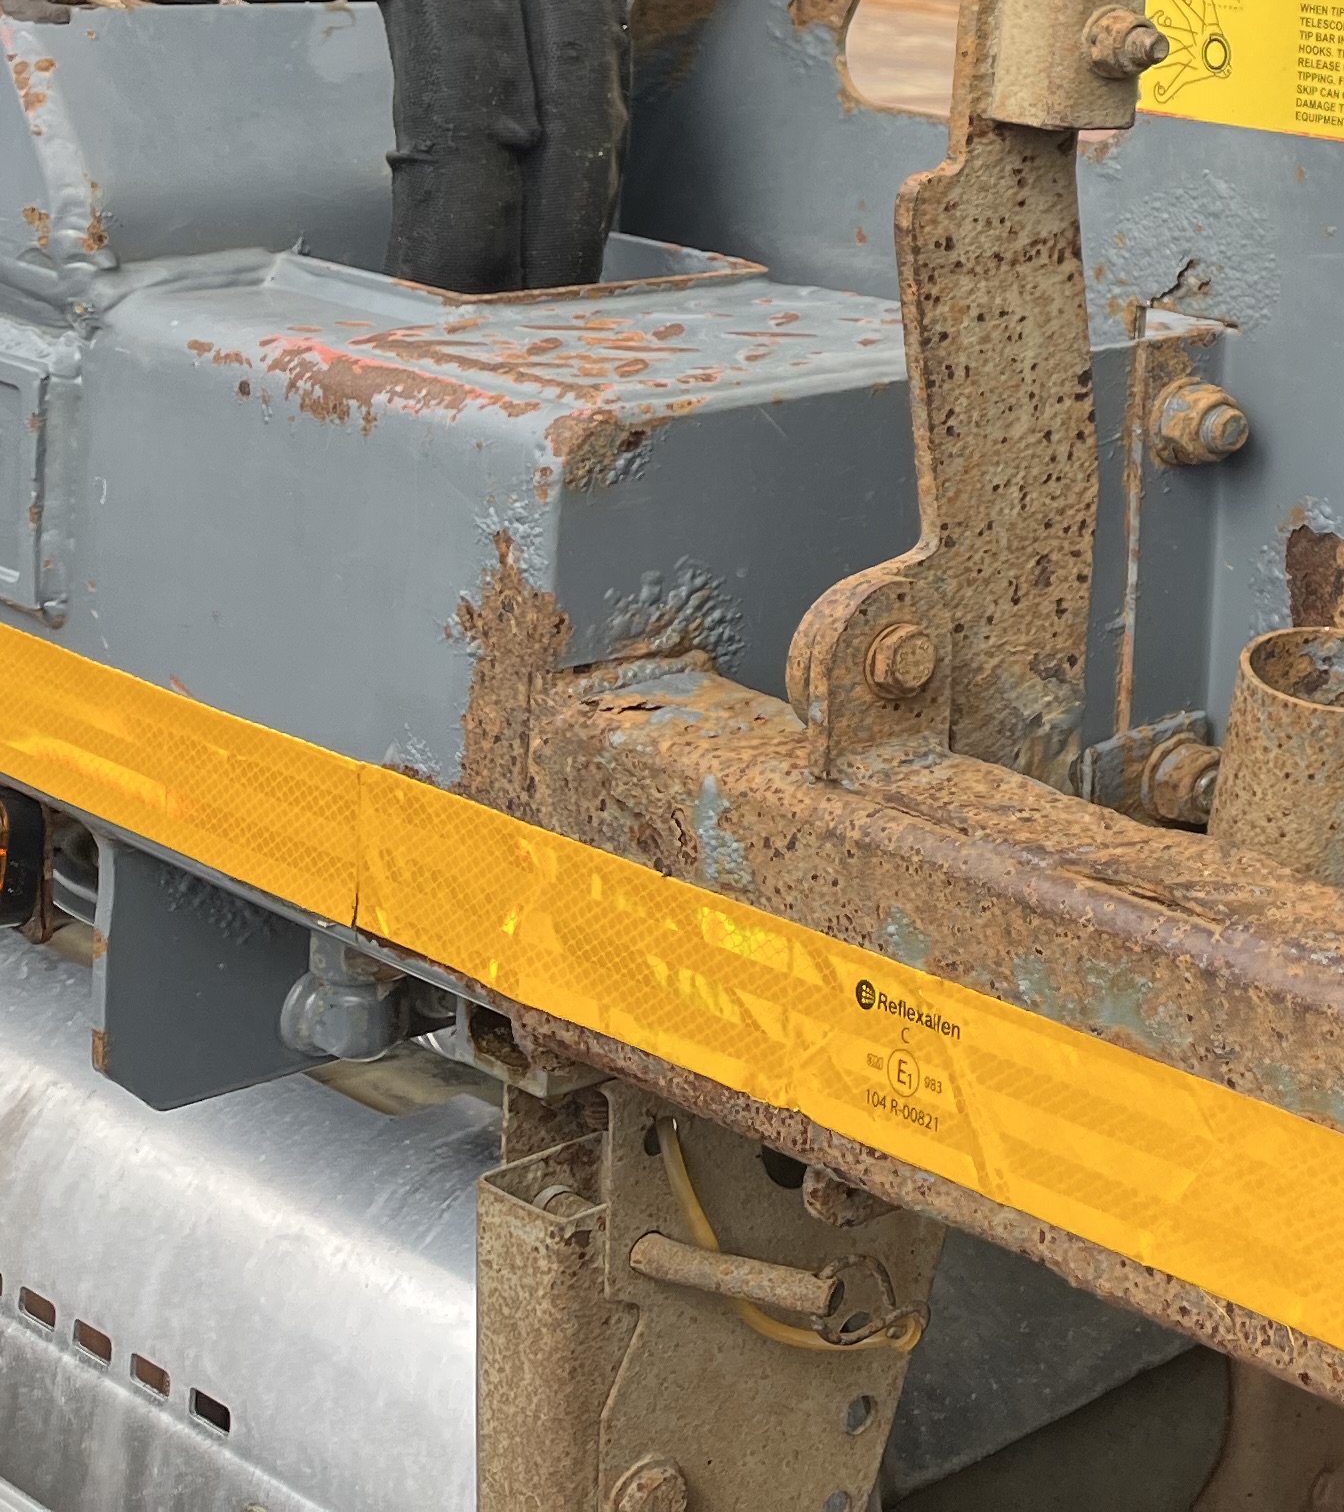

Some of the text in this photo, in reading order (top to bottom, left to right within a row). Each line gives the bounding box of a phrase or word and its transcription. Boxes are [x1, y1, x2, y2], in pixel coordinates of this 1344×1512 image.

[1300, 3, 1328, 15] WHEN
[1300, 30, 1313, 40] TIP
[1316, 32, 1335, 43] BAR
[1299, 44, 1333, 57] HOOKS.
[1298, 58, 1340, 72] RELEASE
[1298, 71, 1335, 85] TIPPING.
[1296, 84, 1318, 96] SKIP
[1320, 87, 1340, 99] CAN
[1296, 98, 1336, 112] DAMAGE
[878, 992, 961, 1040] Reflexallen
[902, 1028, 910, 1044] C
[866, 1089, 938, 1132] 104 R-00821
